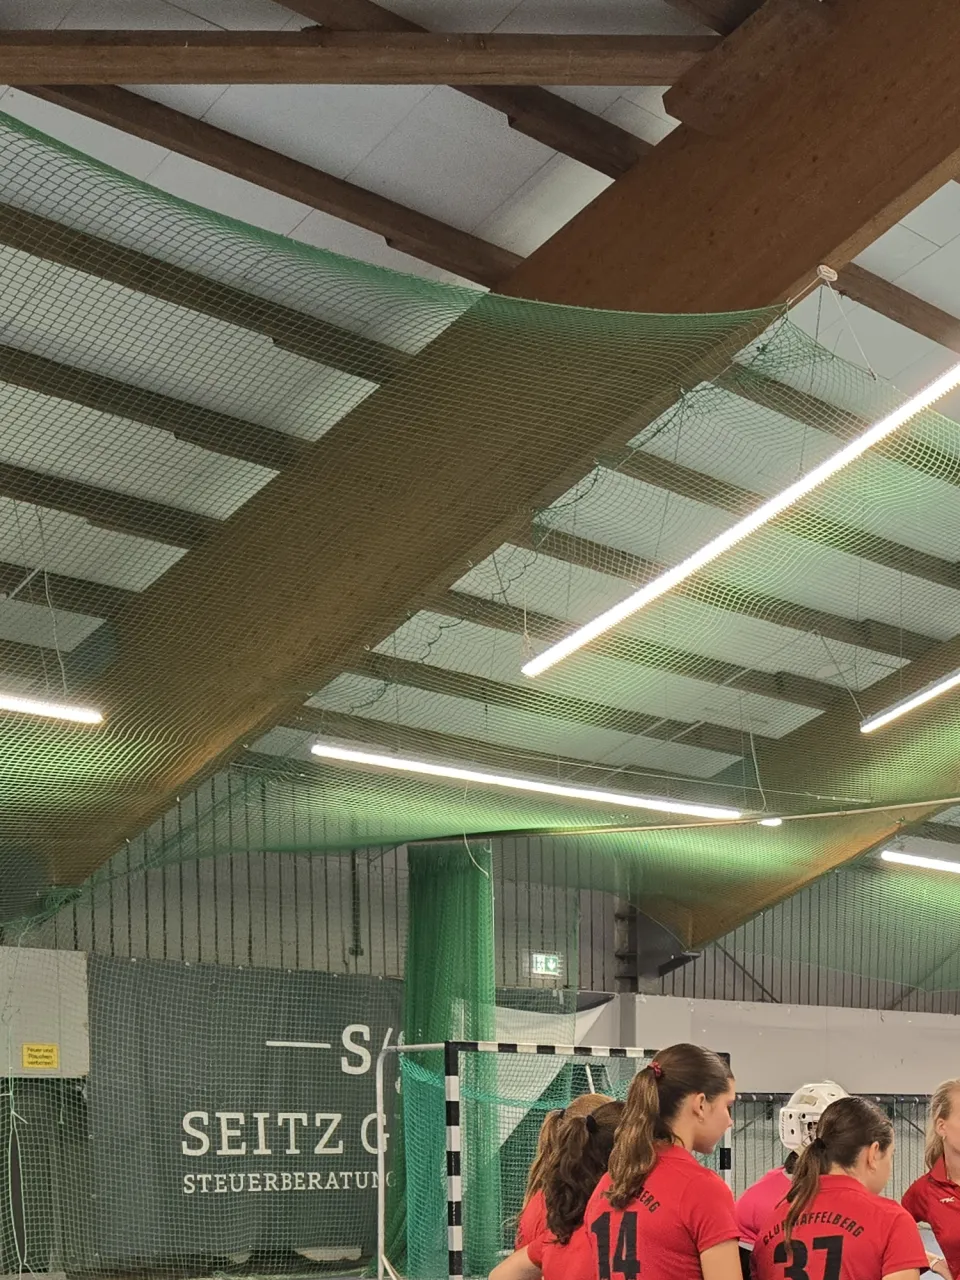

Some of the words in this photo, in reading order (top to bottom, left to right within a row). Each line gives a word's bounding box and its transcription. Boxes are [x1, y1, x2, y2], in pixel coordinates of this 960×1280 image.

[181, 1110, 344, 1156] SEITZ
[361, 1112, 390, 1155] G
[796, 1211, 865, 1238] AFFELBERG
